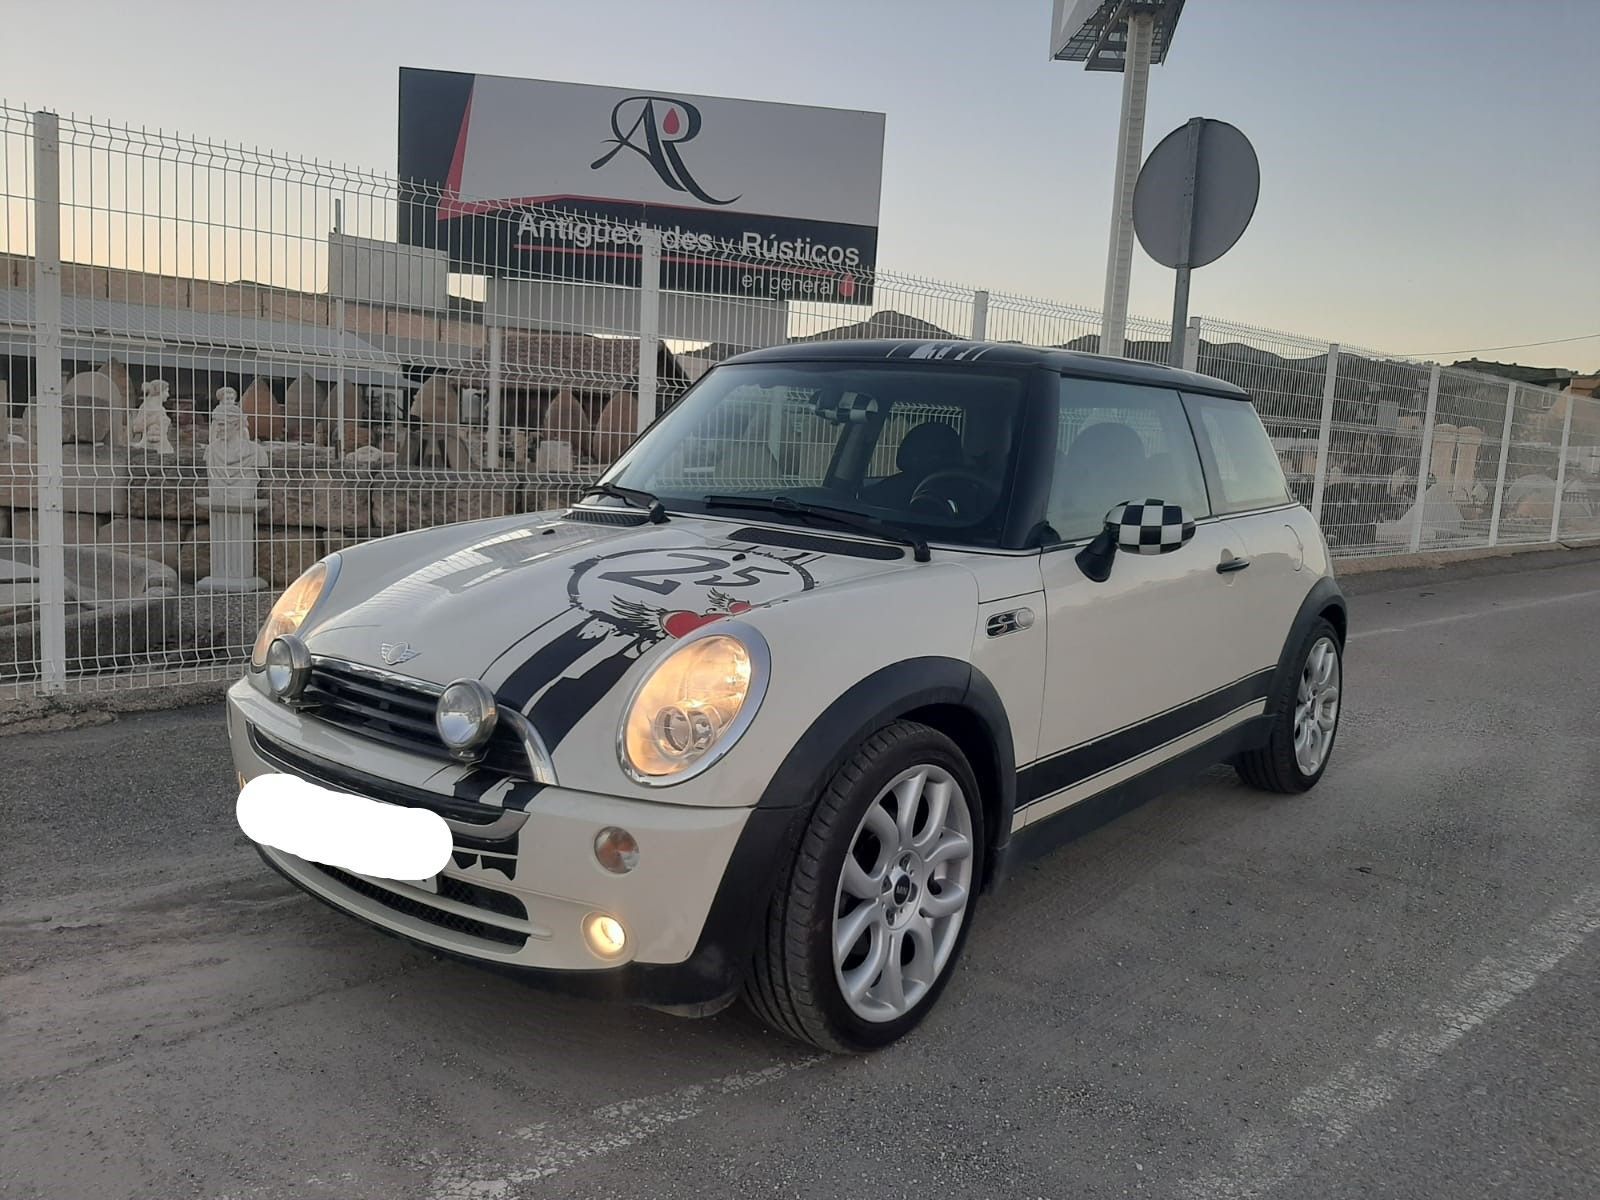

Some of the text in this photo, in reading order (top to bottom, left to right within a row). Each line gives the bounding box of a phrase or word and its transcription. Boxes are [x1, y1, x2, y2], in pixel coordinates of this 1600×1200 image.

[517, 212, 713, 249] Antigüeddes
[742, 232, 860, 266] Rústicos
[741, 274, 833, 295] en general
[598, 553, 790, 595] 25
